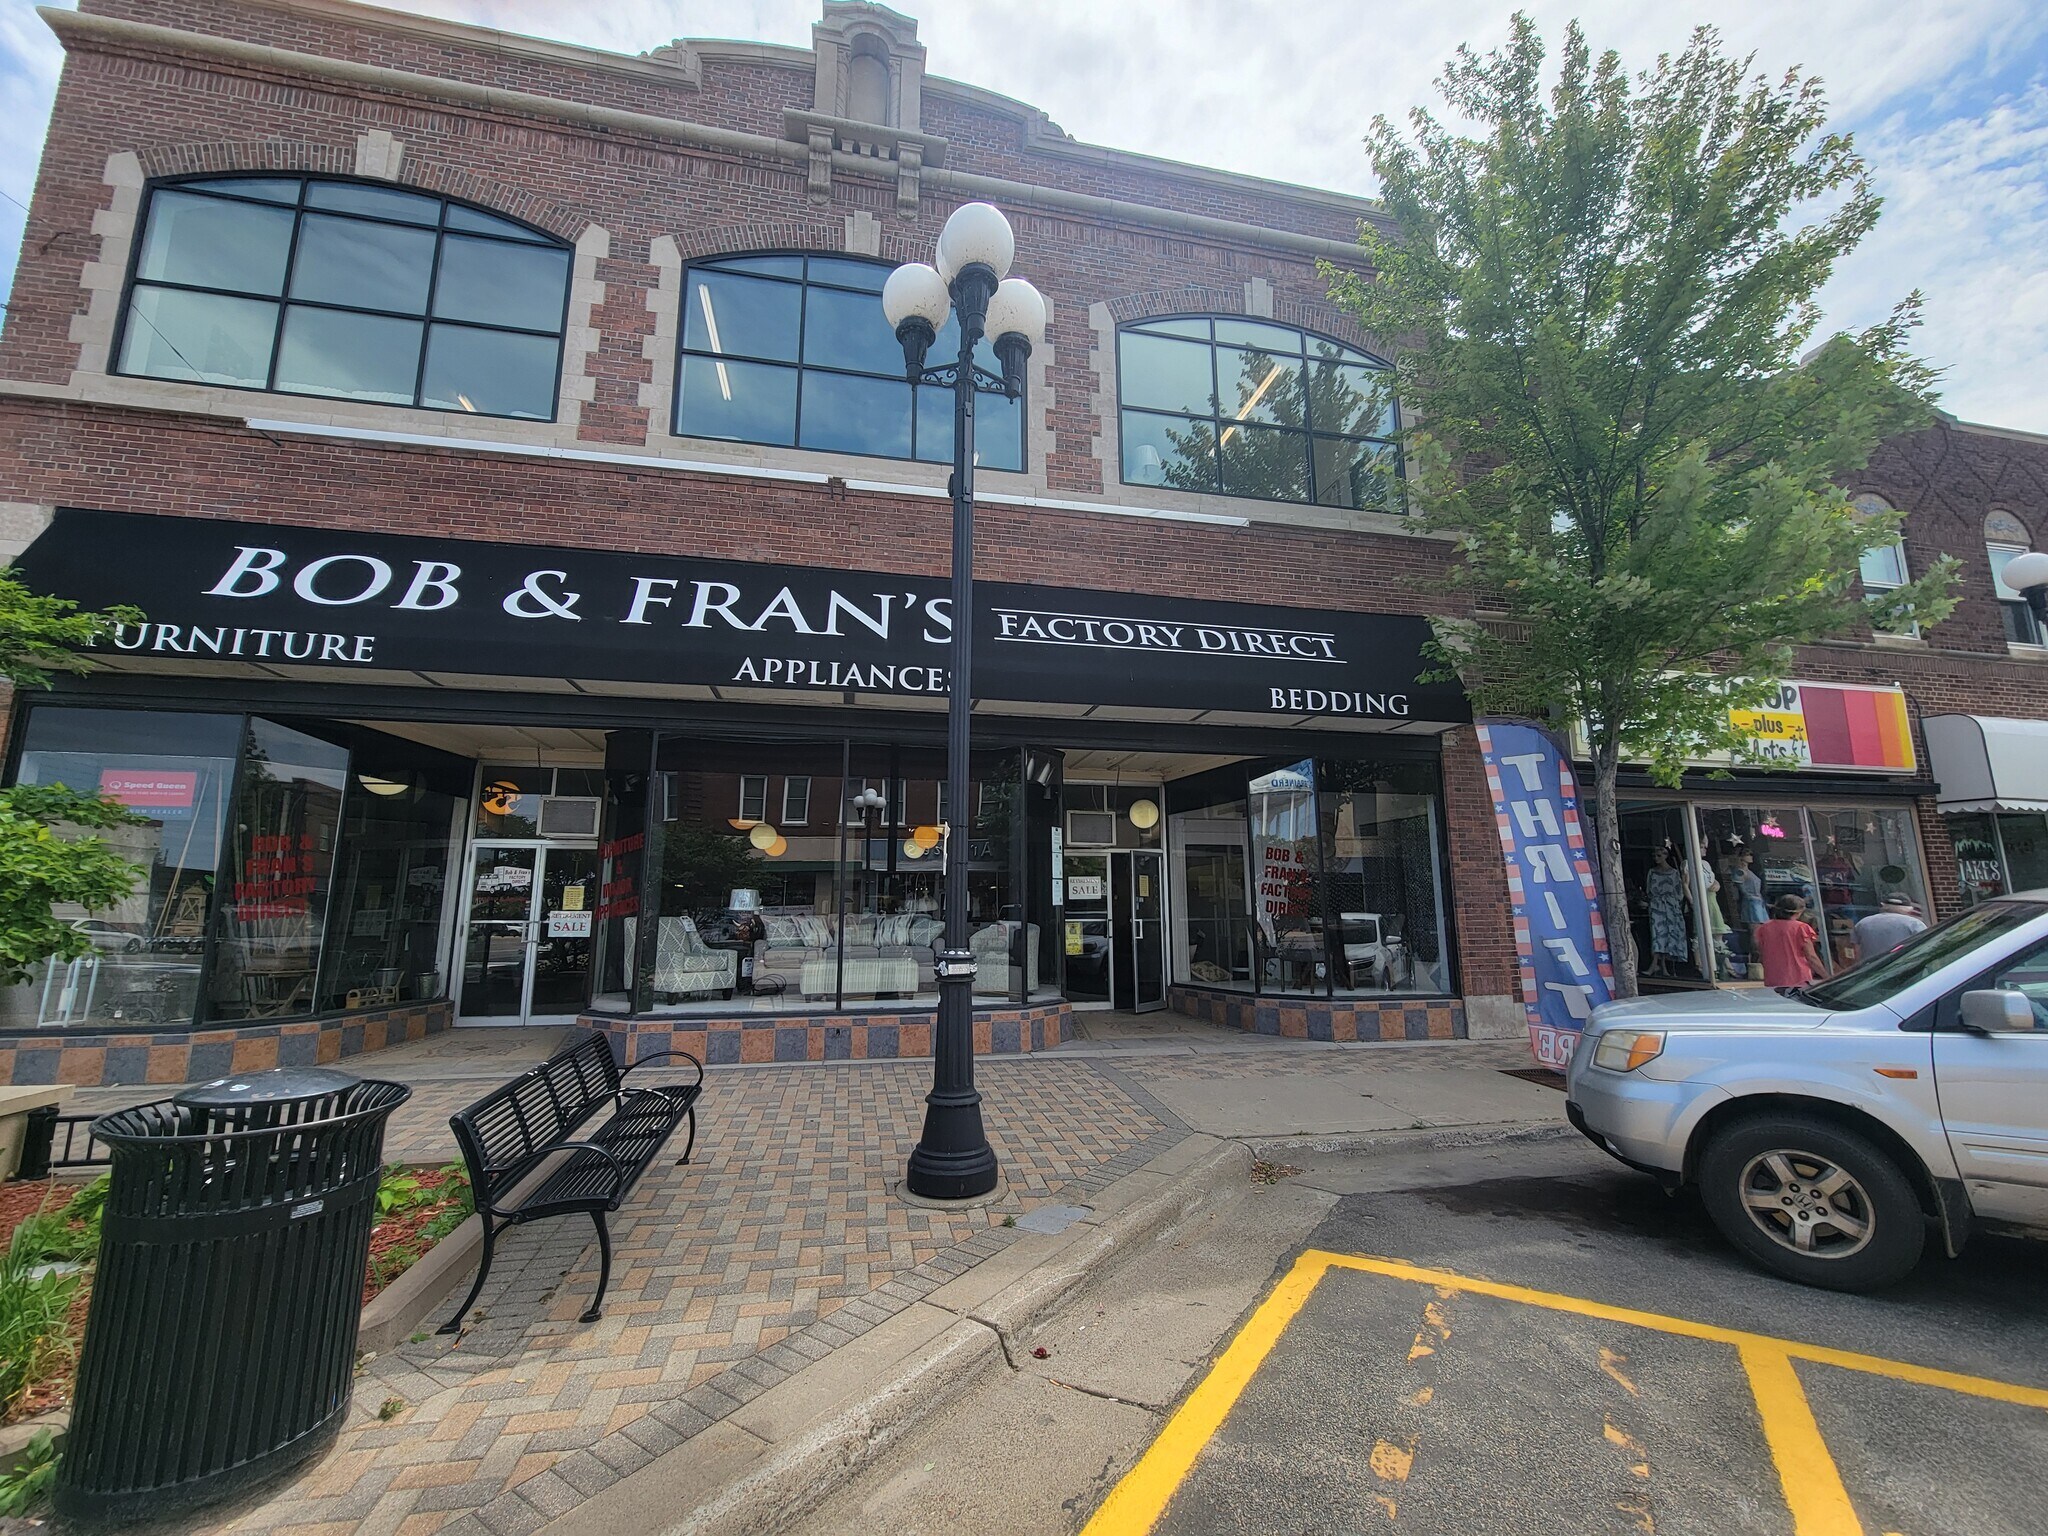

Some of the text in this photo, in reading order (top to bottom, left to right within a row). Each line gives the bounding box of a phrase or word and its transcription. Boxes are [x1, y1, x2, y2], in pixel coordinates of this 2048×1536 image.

[201, 545, 953, 643] BOB & FRAN'S
[998, 613, 1338, 659] FACTORY DIRECT
[1268, 687, 1410, 716] BEDDING
[1753, 713, 1784, 734] plus
[124, 781, 187, 790] Speed Queen
[1265, 846, 1304, 864] BOB &
[1072, 886, 1098, 895] SALE
[553, 921, 587, 932] SALE
